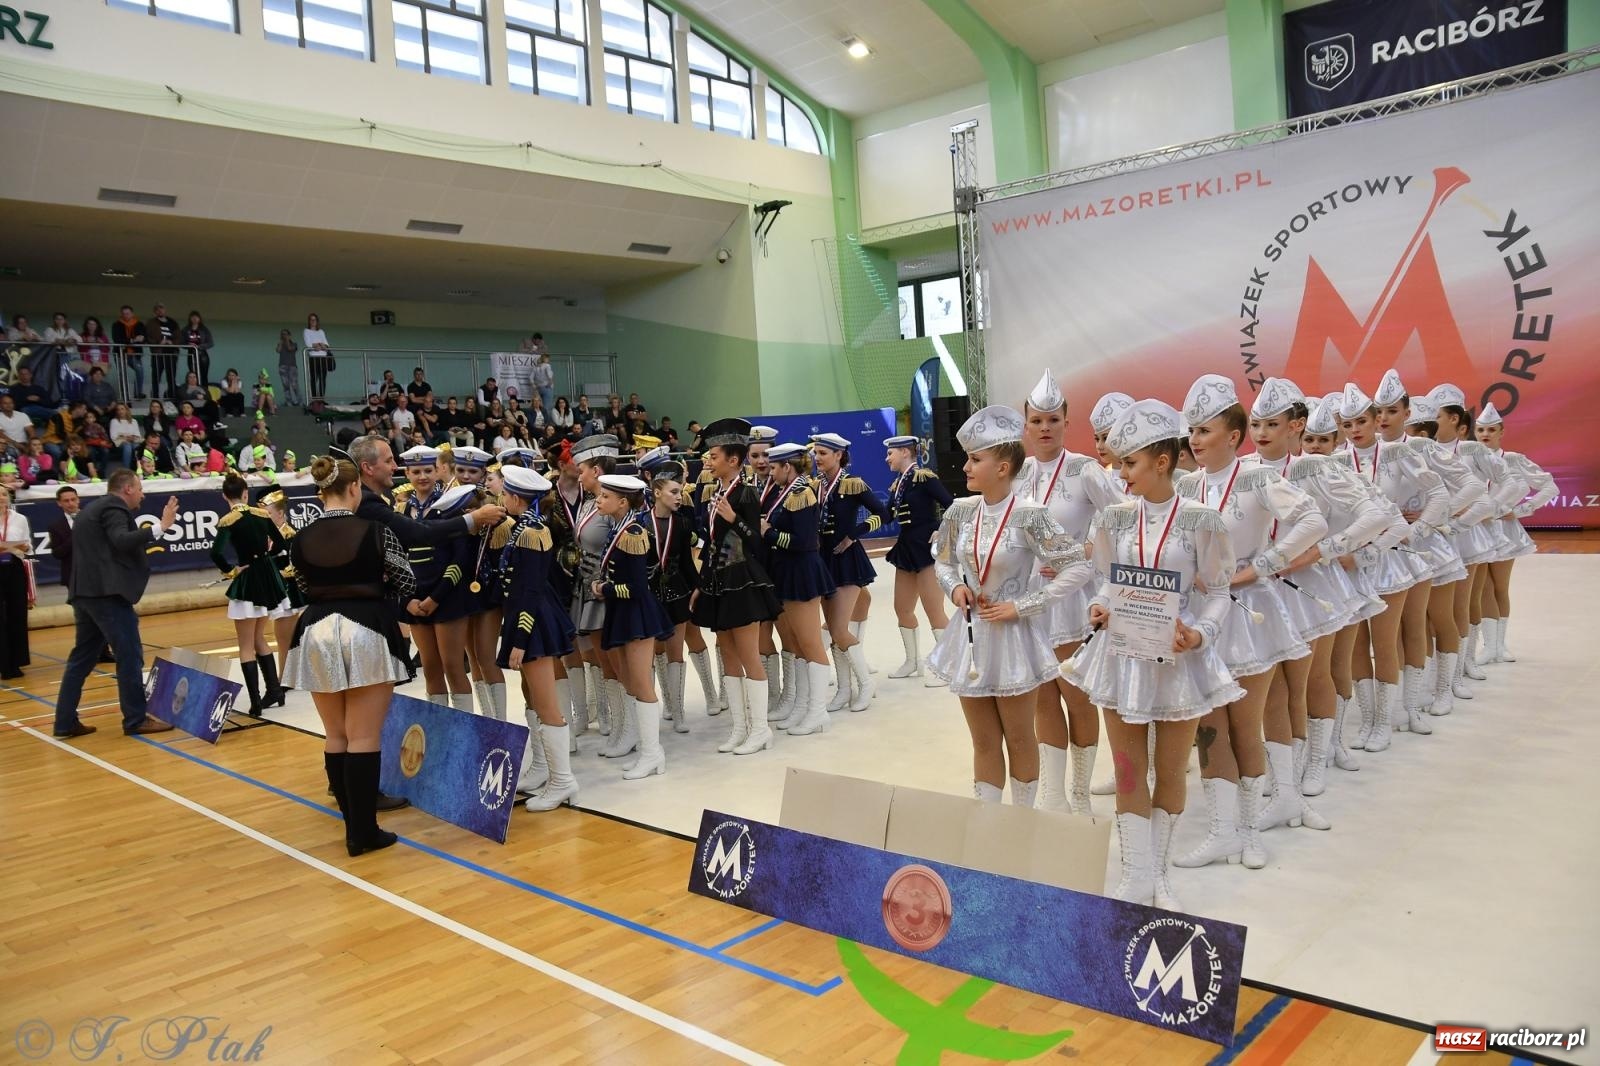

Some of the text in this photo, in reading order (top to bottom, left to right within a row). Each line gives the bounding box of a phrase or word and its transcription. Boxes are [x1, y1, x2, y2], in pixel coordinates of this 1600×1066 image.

[1372, 0, 1544, 64] RACIBÓRZ
[992, 169, 1272, 235] WWW.MAZORETKI.PL
[1240, 175, 1413, 392] ZWIĄZEK SPORTOWY
[1474, 208, 1553, 425] ORETEK
[498, 355, 538, 367] MIESZK
[170, 539, 214, 552] RACIBÓ
[1116, 569, 1176, 591] DYPLOM
[1138, 918, 1190, 937] SPORTOWY
[1160, 946, 1223, 1025] MAŻORETEK
